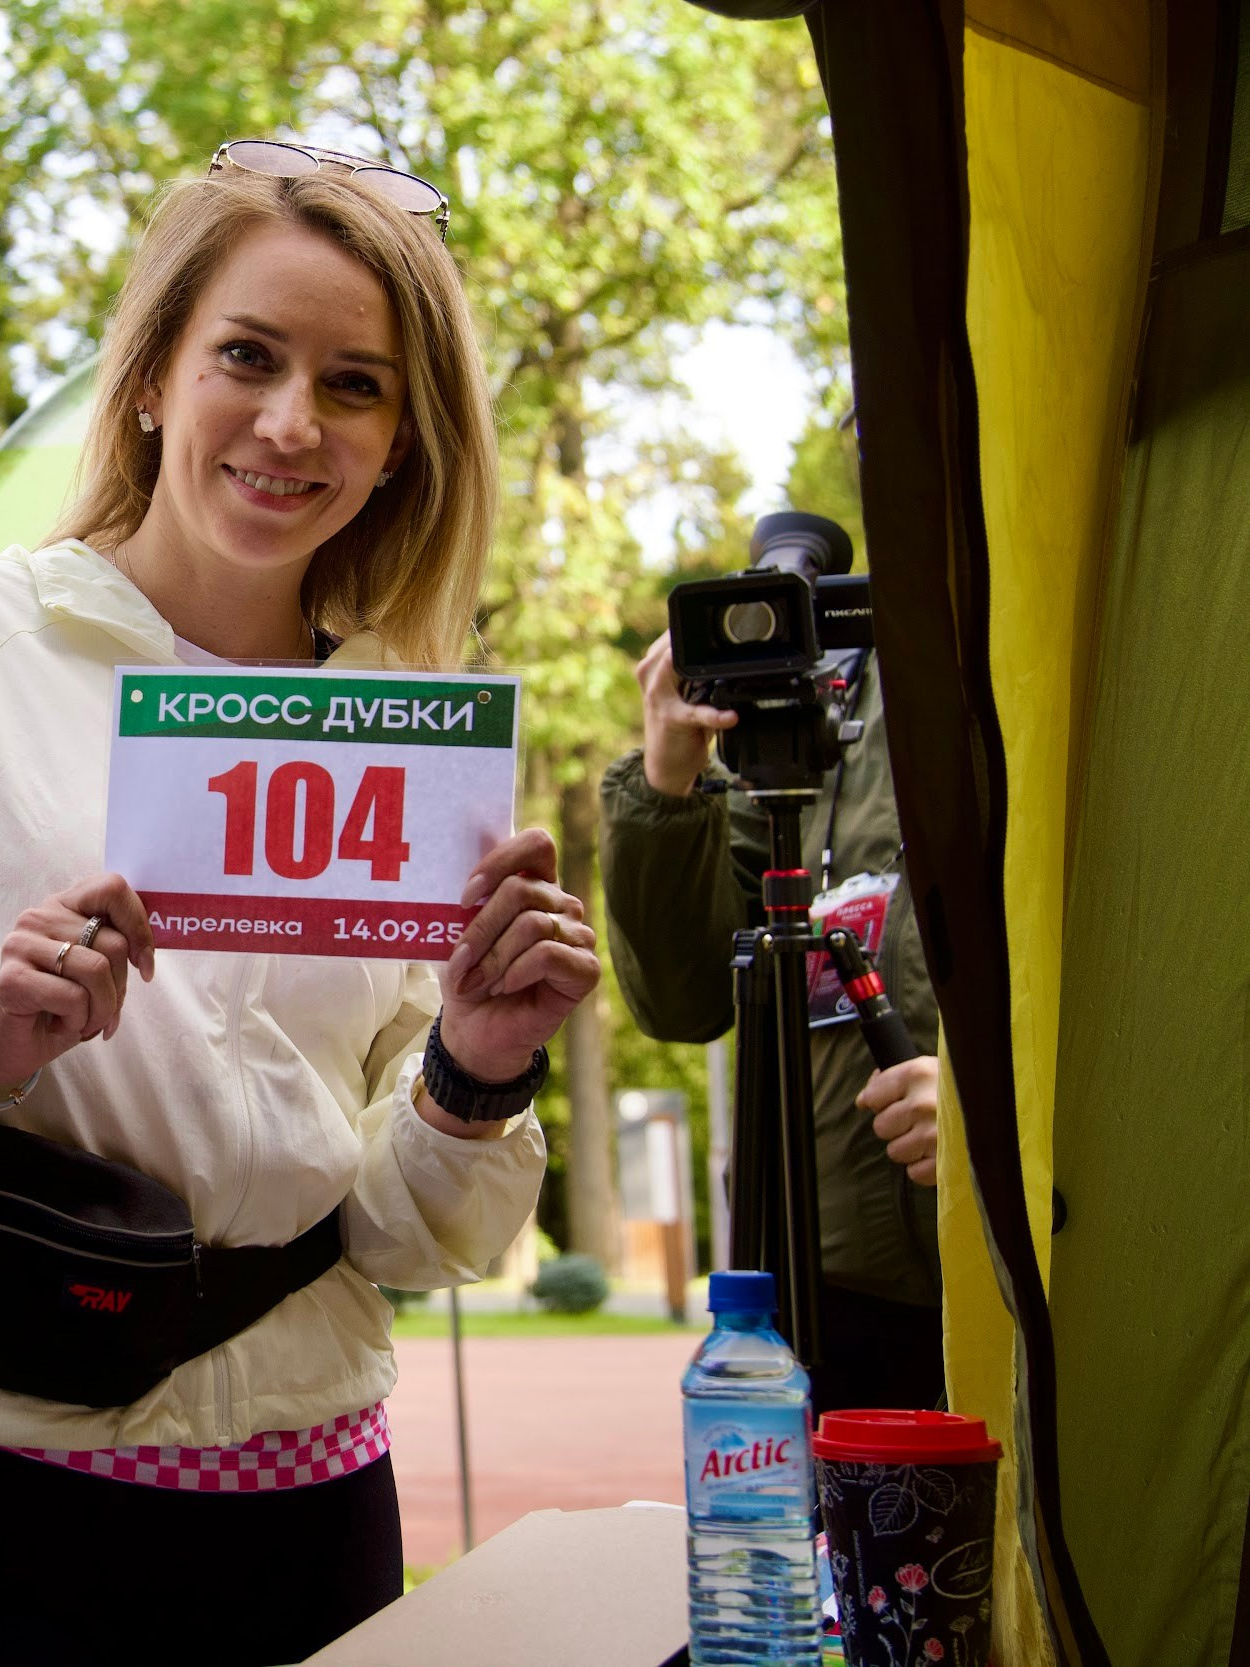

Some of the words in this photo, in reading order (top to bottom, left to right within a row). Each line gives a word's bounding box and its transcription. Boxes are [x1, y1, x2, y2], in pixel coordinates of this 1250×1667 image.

[158, 692, 312, 726] КРОСС
[323, 697, 475, 733] ДУБКИ
[207, 760, 410, 882] 104
[148, 911, 303, 936] Апрелевка
[333, 917, 465, 944] 14.09.25
[69, 1283, 133, 1313] RAY
[700, 1437, 791, 1483] Arctic
